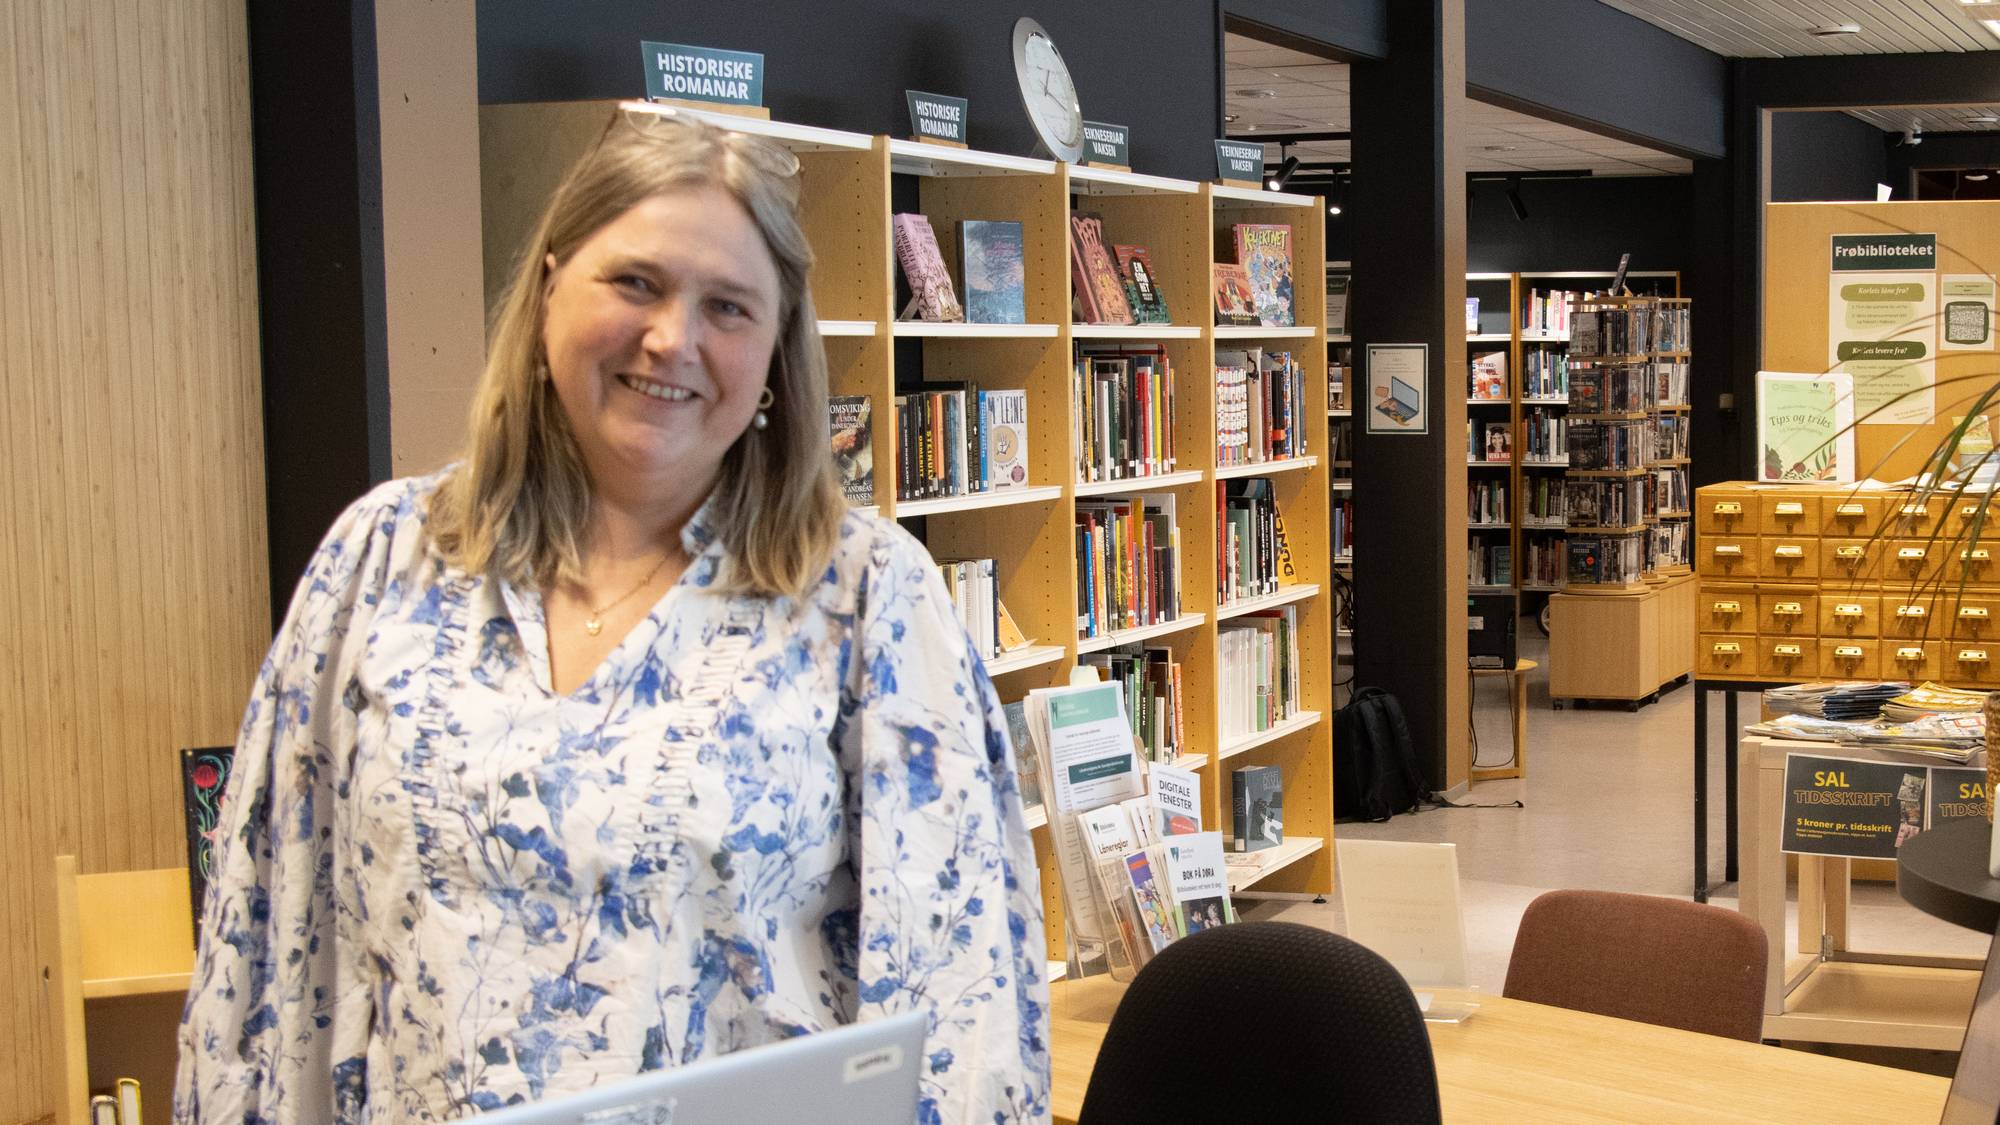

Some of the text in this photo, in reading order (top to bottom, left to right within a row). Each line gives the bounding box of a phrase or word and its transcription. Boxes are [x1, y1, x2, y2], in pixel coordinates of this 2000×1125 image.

[657, 53, 753, 80] HISTORISKE
[663, 73, 749, 99] ROMANAR
[915, 100, 960, 122] HISTORISKE
[920, 117, 958, 138] ROMANAR
[1084, 127, 1124, 145] EIKNESERIAR
[1093, 141, 1116, 157] VAKSEN
[1221, 145, 1261, 160] TEIKNESERIAR
[1231, 159, 1253, 172] VAKSEN
[1835, 244, 1933, 256] Frøbiblioteket
[829, 404, 870, 414] OMSVIKING
[1769, 414, 1831, 428] Tips og triks
[1814, 771, 1850, 787] SAL
[1159, 780, 1190, 797] DIGITALE
[1158, 792, 1192, 810] TENESTER
[1794, 790, 1893, 806] TIDSSKRIFT
[1939, 803, 1987, 817] TIDSS
[1797, 818, 1802, 826] 5
[1804, 819, 1834, 829] kroner
[1836, 823, 1849, 831] pr.
[1850, 822, 1892, 833] tidsskrift
[1182, 867, 1215, 880] BOK PÅ DØRA
